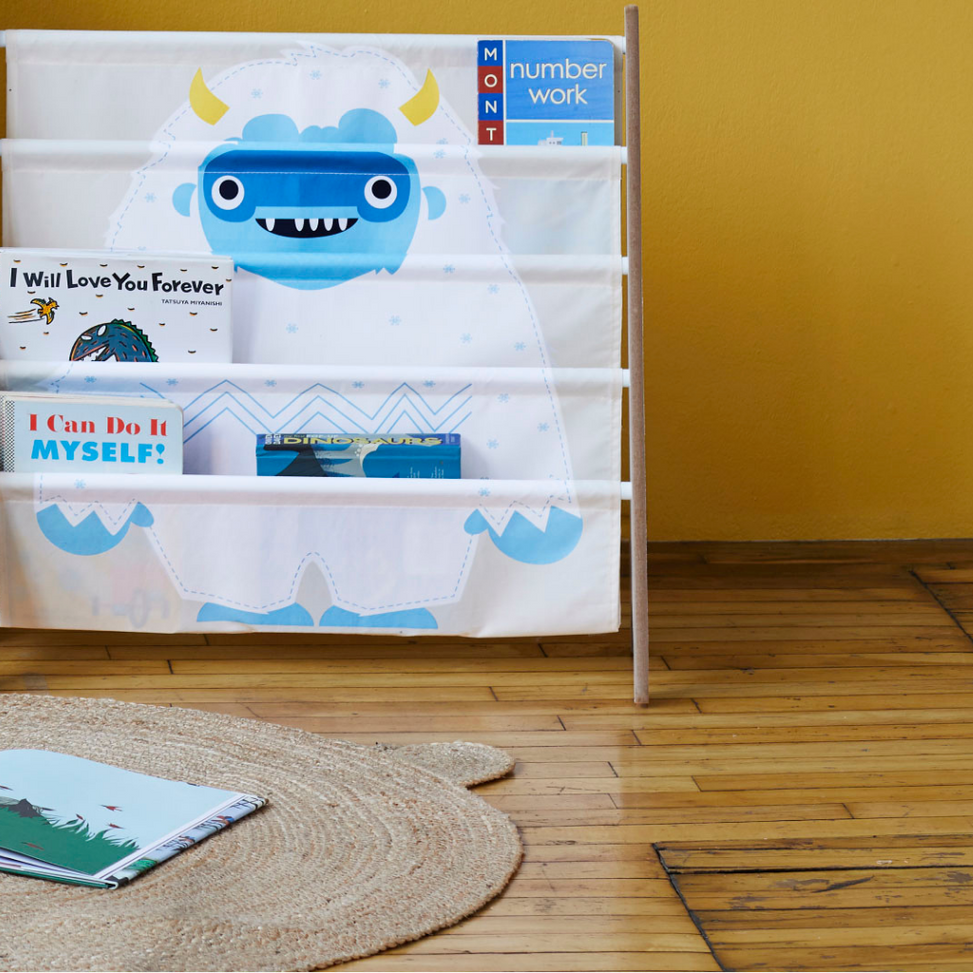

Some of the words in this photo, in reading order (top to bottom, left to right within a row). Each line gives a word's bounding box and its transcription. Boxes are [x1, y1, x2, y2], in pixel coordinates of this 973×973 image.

[510, 58, 607, 79] number
[528, 83, 588, 105] work
[10, 267, 18, 288] I
[23, 271, 62, 288] Will
[66, 269, 112, 289] Love
[112, 272, 148, 292] You
[151, 272, 224, 296] Forever
[29, 413, 38, 432] I
[47, 414, 96, 433] Can
[106, 416, 141, 435] Do
[150, 418, 168, 437] It
[30, 439, 166, 465] MYSELF!
[283, 437, 442, 445] DINOSAURS
